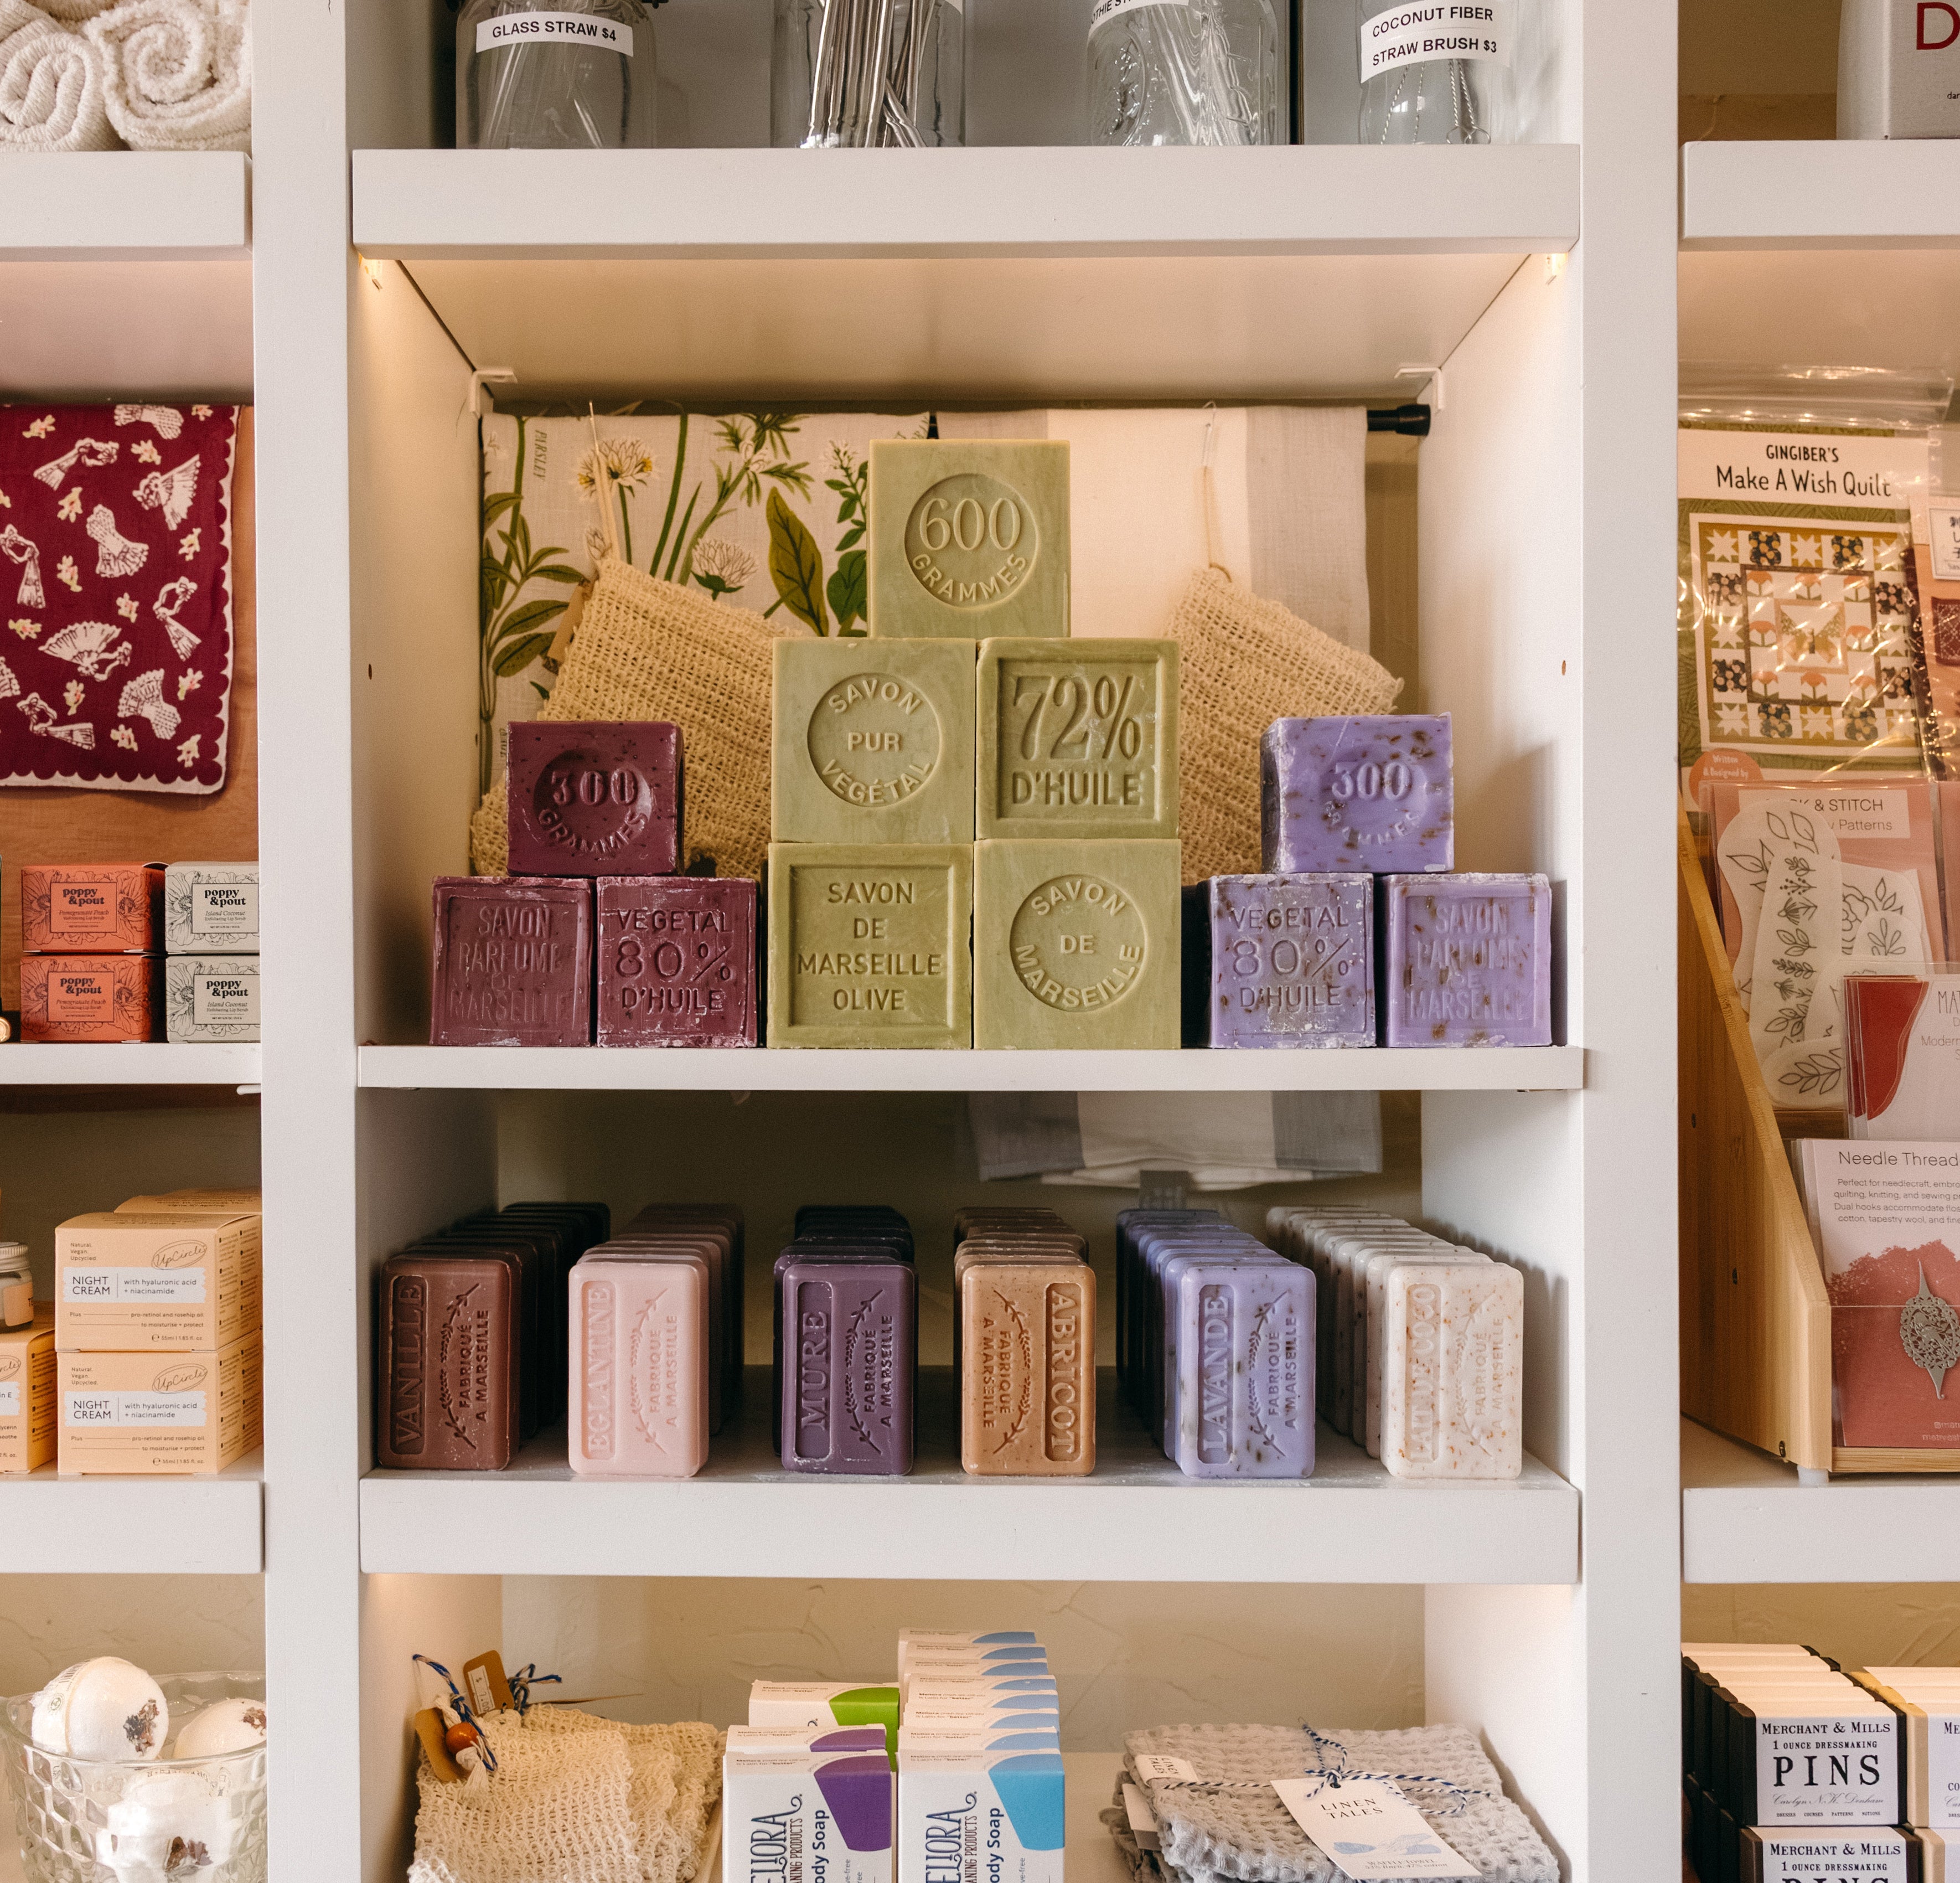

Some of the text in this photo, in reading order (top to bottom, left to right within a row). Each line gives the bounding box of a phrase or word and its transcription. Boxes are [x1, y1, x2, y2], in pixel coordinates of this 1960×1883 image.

[493, 21, 616, 42] GLASS STRAW $4
[1373, 7, 1493, 37] COCONUT FIBER
[1373, 38, 1497, 66] STRAW BRUSH $3
[1766, 445, 1839, 462] GINGIBER'S
[1716, 465, 1891, 497] Make A Wish Quilt
[919, 498, 1021, 551] 600
[913, 554, 1026, 602] GRAMMES
[829, 679, 921, 716] SAVON
[1013, 675, 1143, 760] 72%
[848, 732, 902, 752] PUR
[552, 771, 638, 805] 300
[1012, 769, 1144, 806] D'HUILE
[1332, 762, 1413, 800] 300
[1814, 799, 1883, 811] & STITCH
[1839, 819, 1892, 830] Patterns
[63, 889, 98, 897] poppy
[204, 889, 239, 898] poppy
[828, 883, 913, 904] SAVON
[1031, 880, 1126, 917] SAVON
[479, 906, 550, 938] SAVON
[617, 910, 733, 933] VEGETAL
[854, 918, 886, 939] DE
[1230, 906, 1350, 930] VEGETAL
[1436, 904, 1509, 934] SAVON
[1060, 935, 1094, 955] DE
[798, 953, 941, 976] MARSEILLE
[1016, 943, 1142, 1008] MARSEILLE
[60, 978, 95, 987] poppy
[206, 981, 241, 989] poppy
[622, 987, 723, 1013] D'HUILE
[833, 989, 904, 1010] OLIVE
[1839, 1151, 1897, 1165] Needle
[1834, 1191, 1866, 1200] quilting,
[1869, 1191, 1900, 1200] knitting,
[1921, 1193, 1950, 1201] sewing
[1869, 1215, 1902, 1224] tapestry
[156, 1246, 204, 1267] UpCircle
[73, 1276, 109, 1285] NIGHT
[73, 1286, 110, 1295] CREAM
[396, 1284, 422, 1446] VANILLE
[476, 1310, 489, 1421] A MARSEILLE
[666, 1315, 678, 1427] A MARSEILLE
[801, 1311, 828, 1431] MURE
[882, 1315, 893, 1427] A MARSEILLE
[1052, 1290, 1076, 1454] ABRICOT
[1203, 1297, 1229, 1452] LAVANDE
[1285, 1317, 1297, 1413] MARSEILLE
[1492, 1318, 1505, 1410] MARSEILLE
[156, 1369, 205, 1391] UpCircle
[983, 1338, 995, 1428] MARSEILLE
[74, 1400, 110, 1409] NIGHT
[74, 1410, 111, 1419] CREAM
[1833, 1722, 1845, 1733] &
[1852, 1722, 1890, 1733] MILLS
[1773, 1740, 1779, 1750] 1
[1816, 1741, 1878, 1749] DRESSMAKING
[1773, 1755, 1880, 1787] PINS
[1321, 1798, 1376, 1810] LINEN
[1326, 1807, 1383, 1819] TALES
[790, 1818, 803, 1859] PRODUCTS
[813, 1810, 829, 1850] Soap
[965, 1815, 977, 1856] PRODUCTS
[987, 1808, 1004, 1848] Soap
[1843, 1844, 1855, 1855] &
[1861, 1843, 1901, 1855] MILLS
[1782, 1861, 1787, 1871] 1
